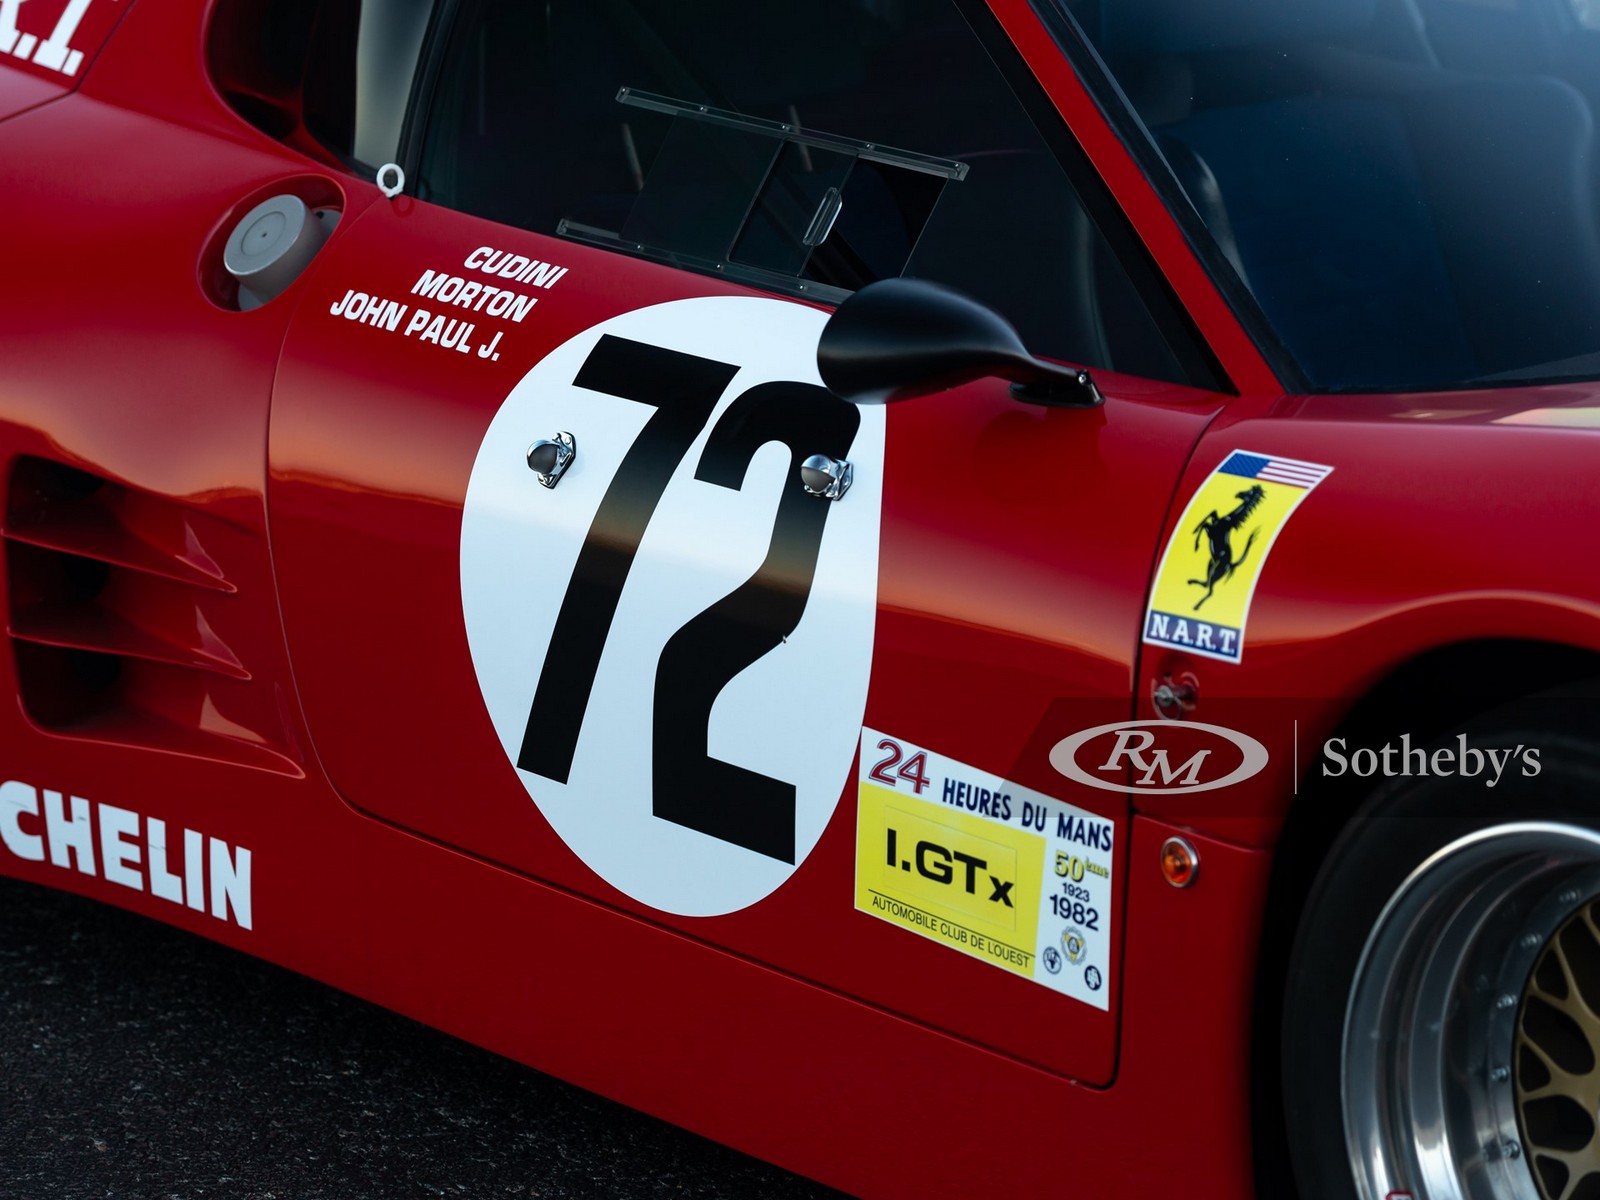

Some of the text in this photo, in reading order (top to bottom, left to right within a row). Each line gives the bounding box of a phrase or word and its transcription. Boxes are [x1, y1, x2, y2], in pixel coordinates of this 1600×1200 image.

[410, 269, 538, 323] MORTON
[463, 246, 569, 290] CUDINI
[329, 289, 504, 362] JOHN PAUL J.
[516, 333, 861, 866] 72
[1149, 613, 1237, 655] N.A.R.T.
[868, 738, 1112, 852] 24 HEURES DU MANS
[0, 780, 252, 931] CHELIN
[1049, 894, 1099, 932] 1982
[1062, 882, 1090, 903] 1923
[872, 895, 938, 932] AUTOMOBILE
[940, 922, 968, 944] CLUB
[970, 934, 985, 951] DE
[987, 941, 1030, 968] L'OUEST
